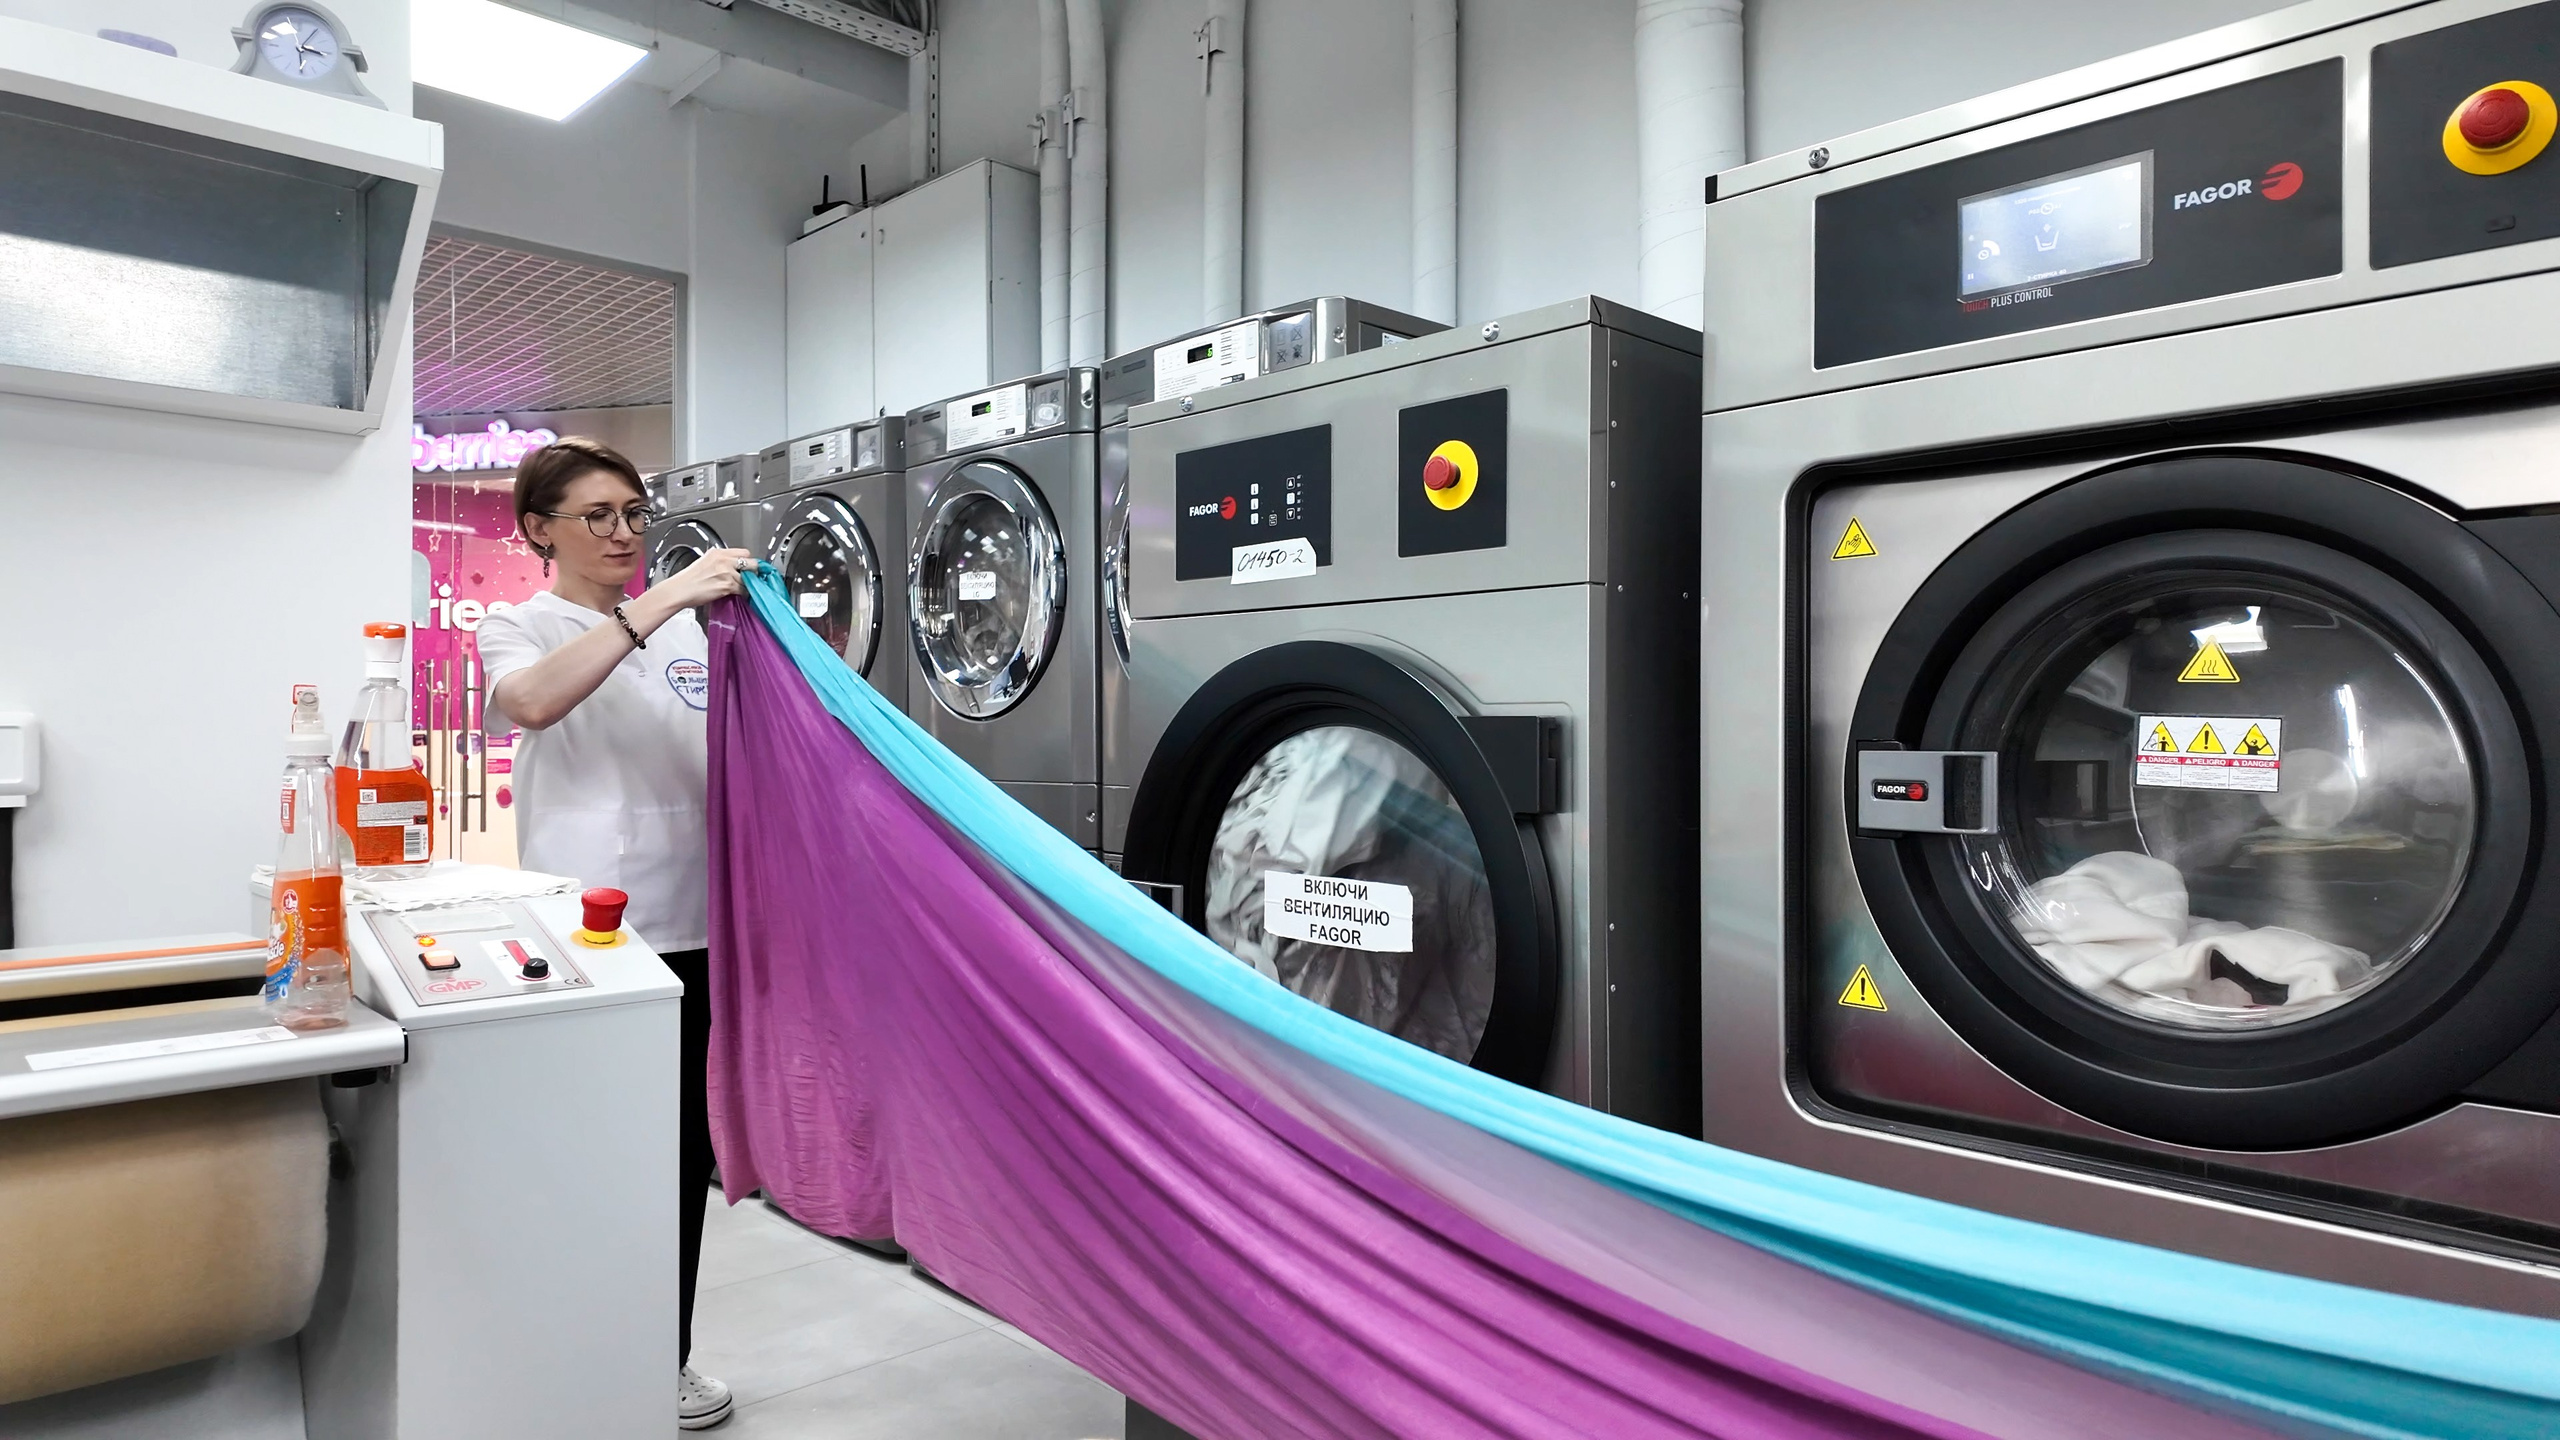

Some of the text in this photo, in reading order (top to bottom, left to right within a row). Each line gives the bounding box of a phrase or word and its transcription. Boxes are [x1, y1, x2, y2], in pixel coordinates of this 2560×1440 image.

[2173, 178, 2253, 211] FAGOR
[1963, 286, 2054, 313] TOUCH PLUS CONTROL
[1189, 502, 1219, 517] FAGOR
[2148, 756, 2179, 764] DANGER
[2192, 758, 2227, 766] PELIGRO
[2241, 760, 2275, 768] DANGER
[1877, 785, 1906, 794] FAGOR
[1303, 878, 1369, 901] ВКЛЮЧИ
[1284, 898, 1390, 926] ВЕНТИЛЯЦИЮ
[1310, 923, 1362, 946] FAGOR
[428, 980, 482, 993] GMP
